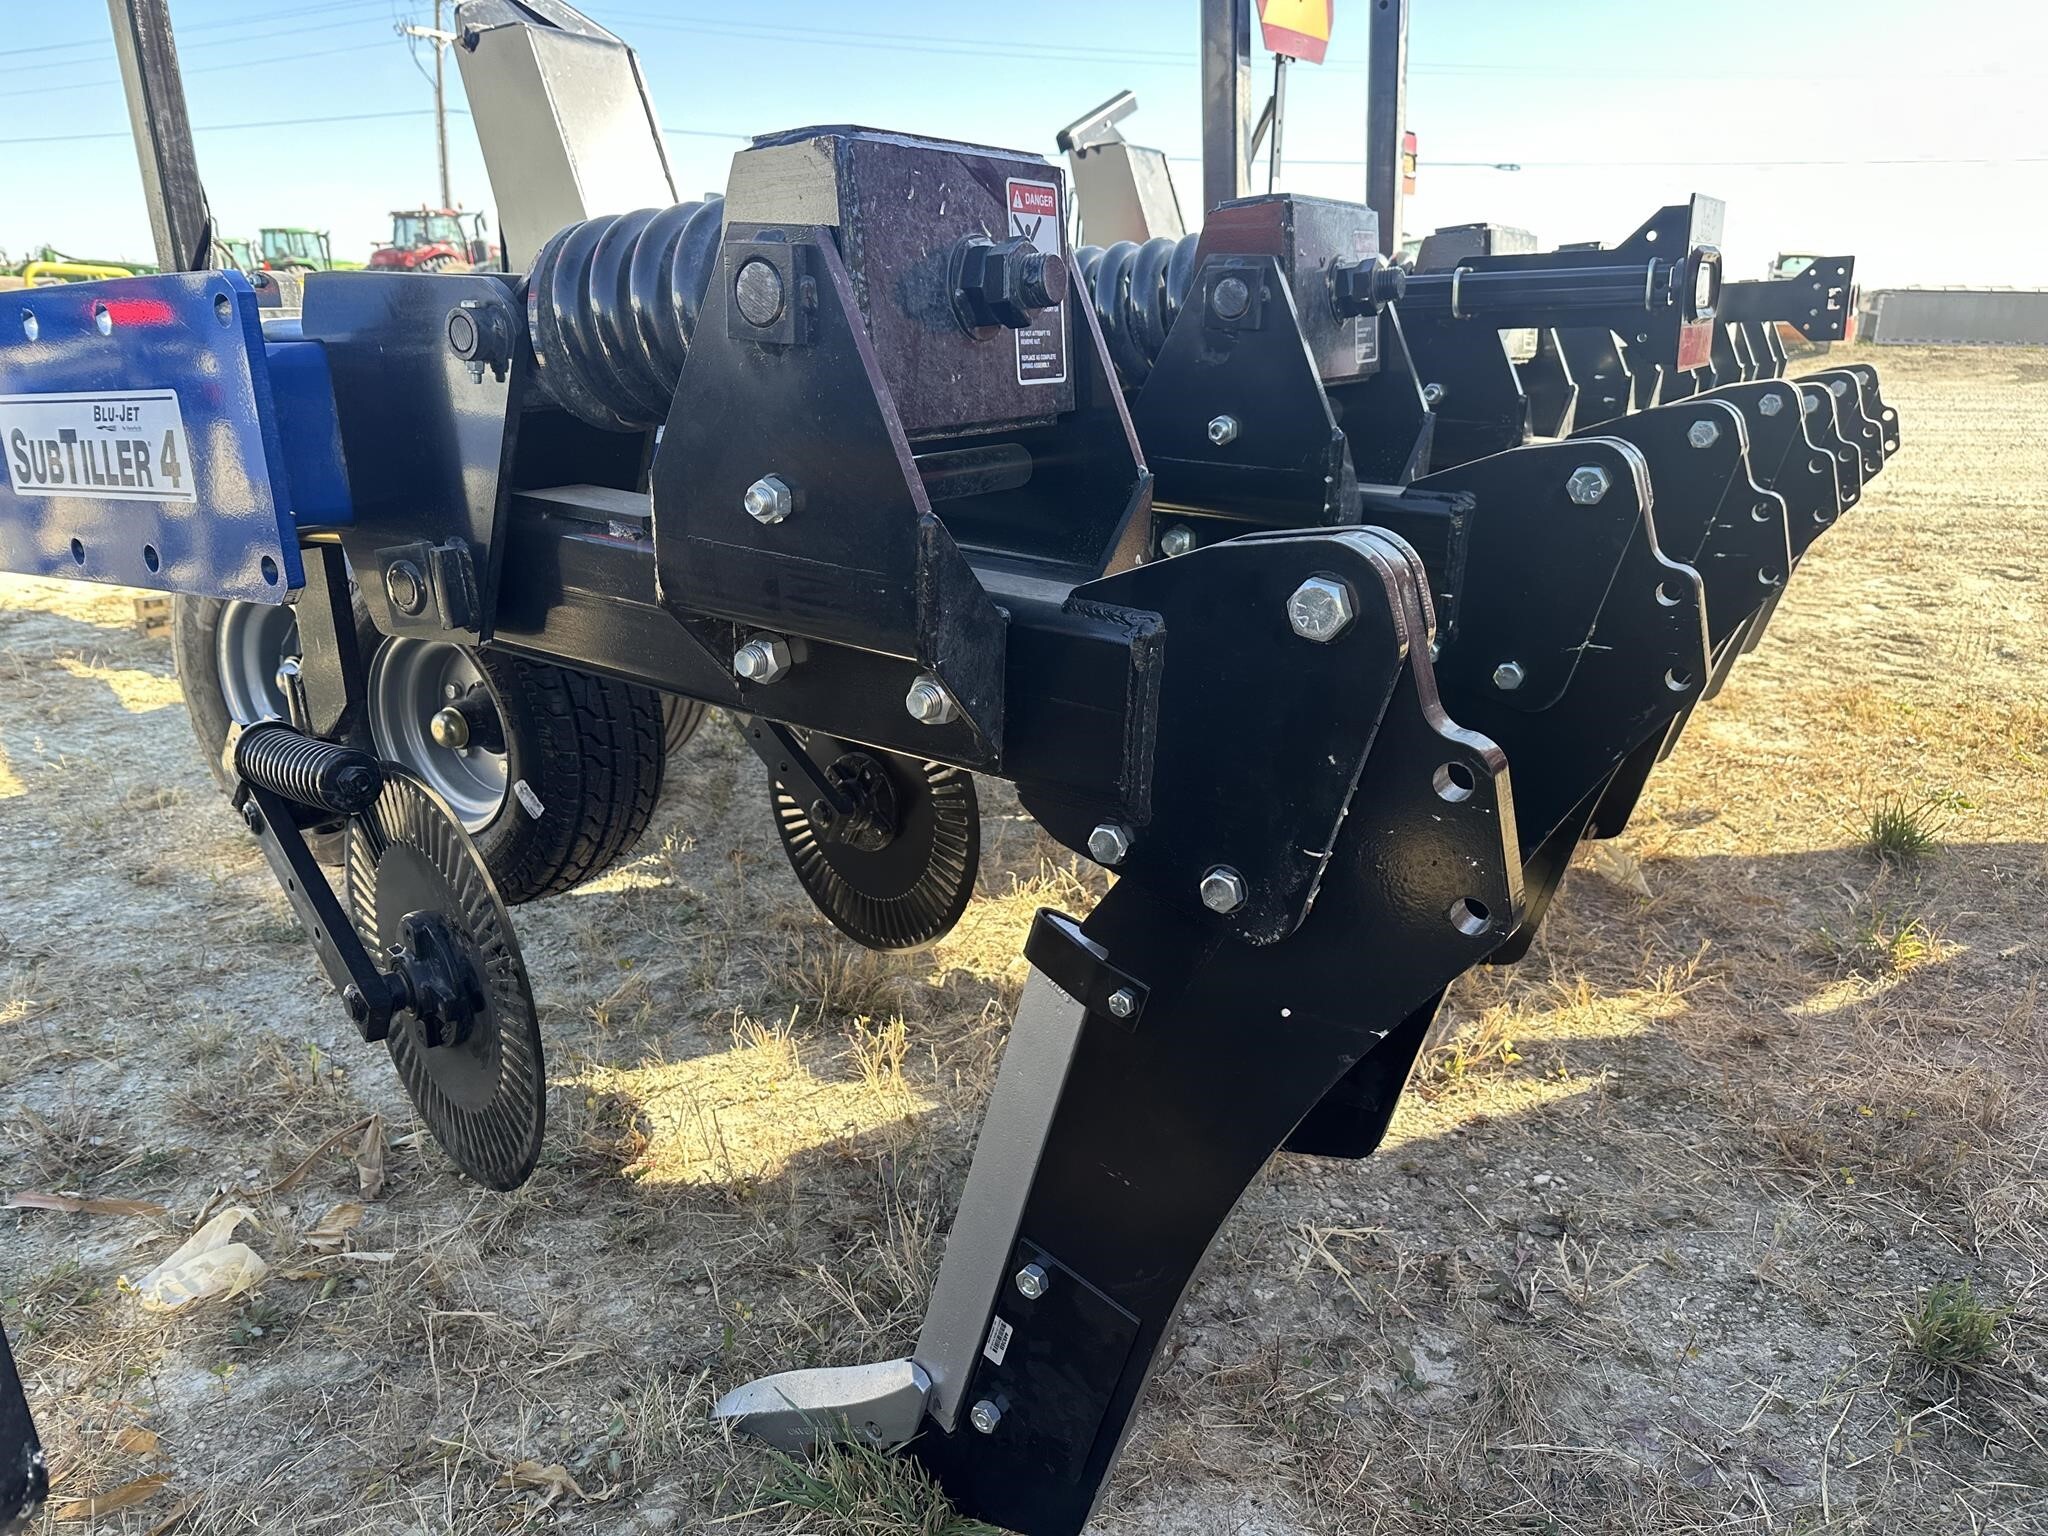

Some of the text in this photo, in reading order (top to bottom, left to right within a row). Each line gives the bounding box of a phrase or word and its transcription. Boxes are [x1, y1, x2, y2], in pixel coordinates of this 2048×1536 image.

[1025, 193, 1053, 207] DANGER
[93, 404, 140, 422] BLU-JET
[160, 430, 182, 488] 4
